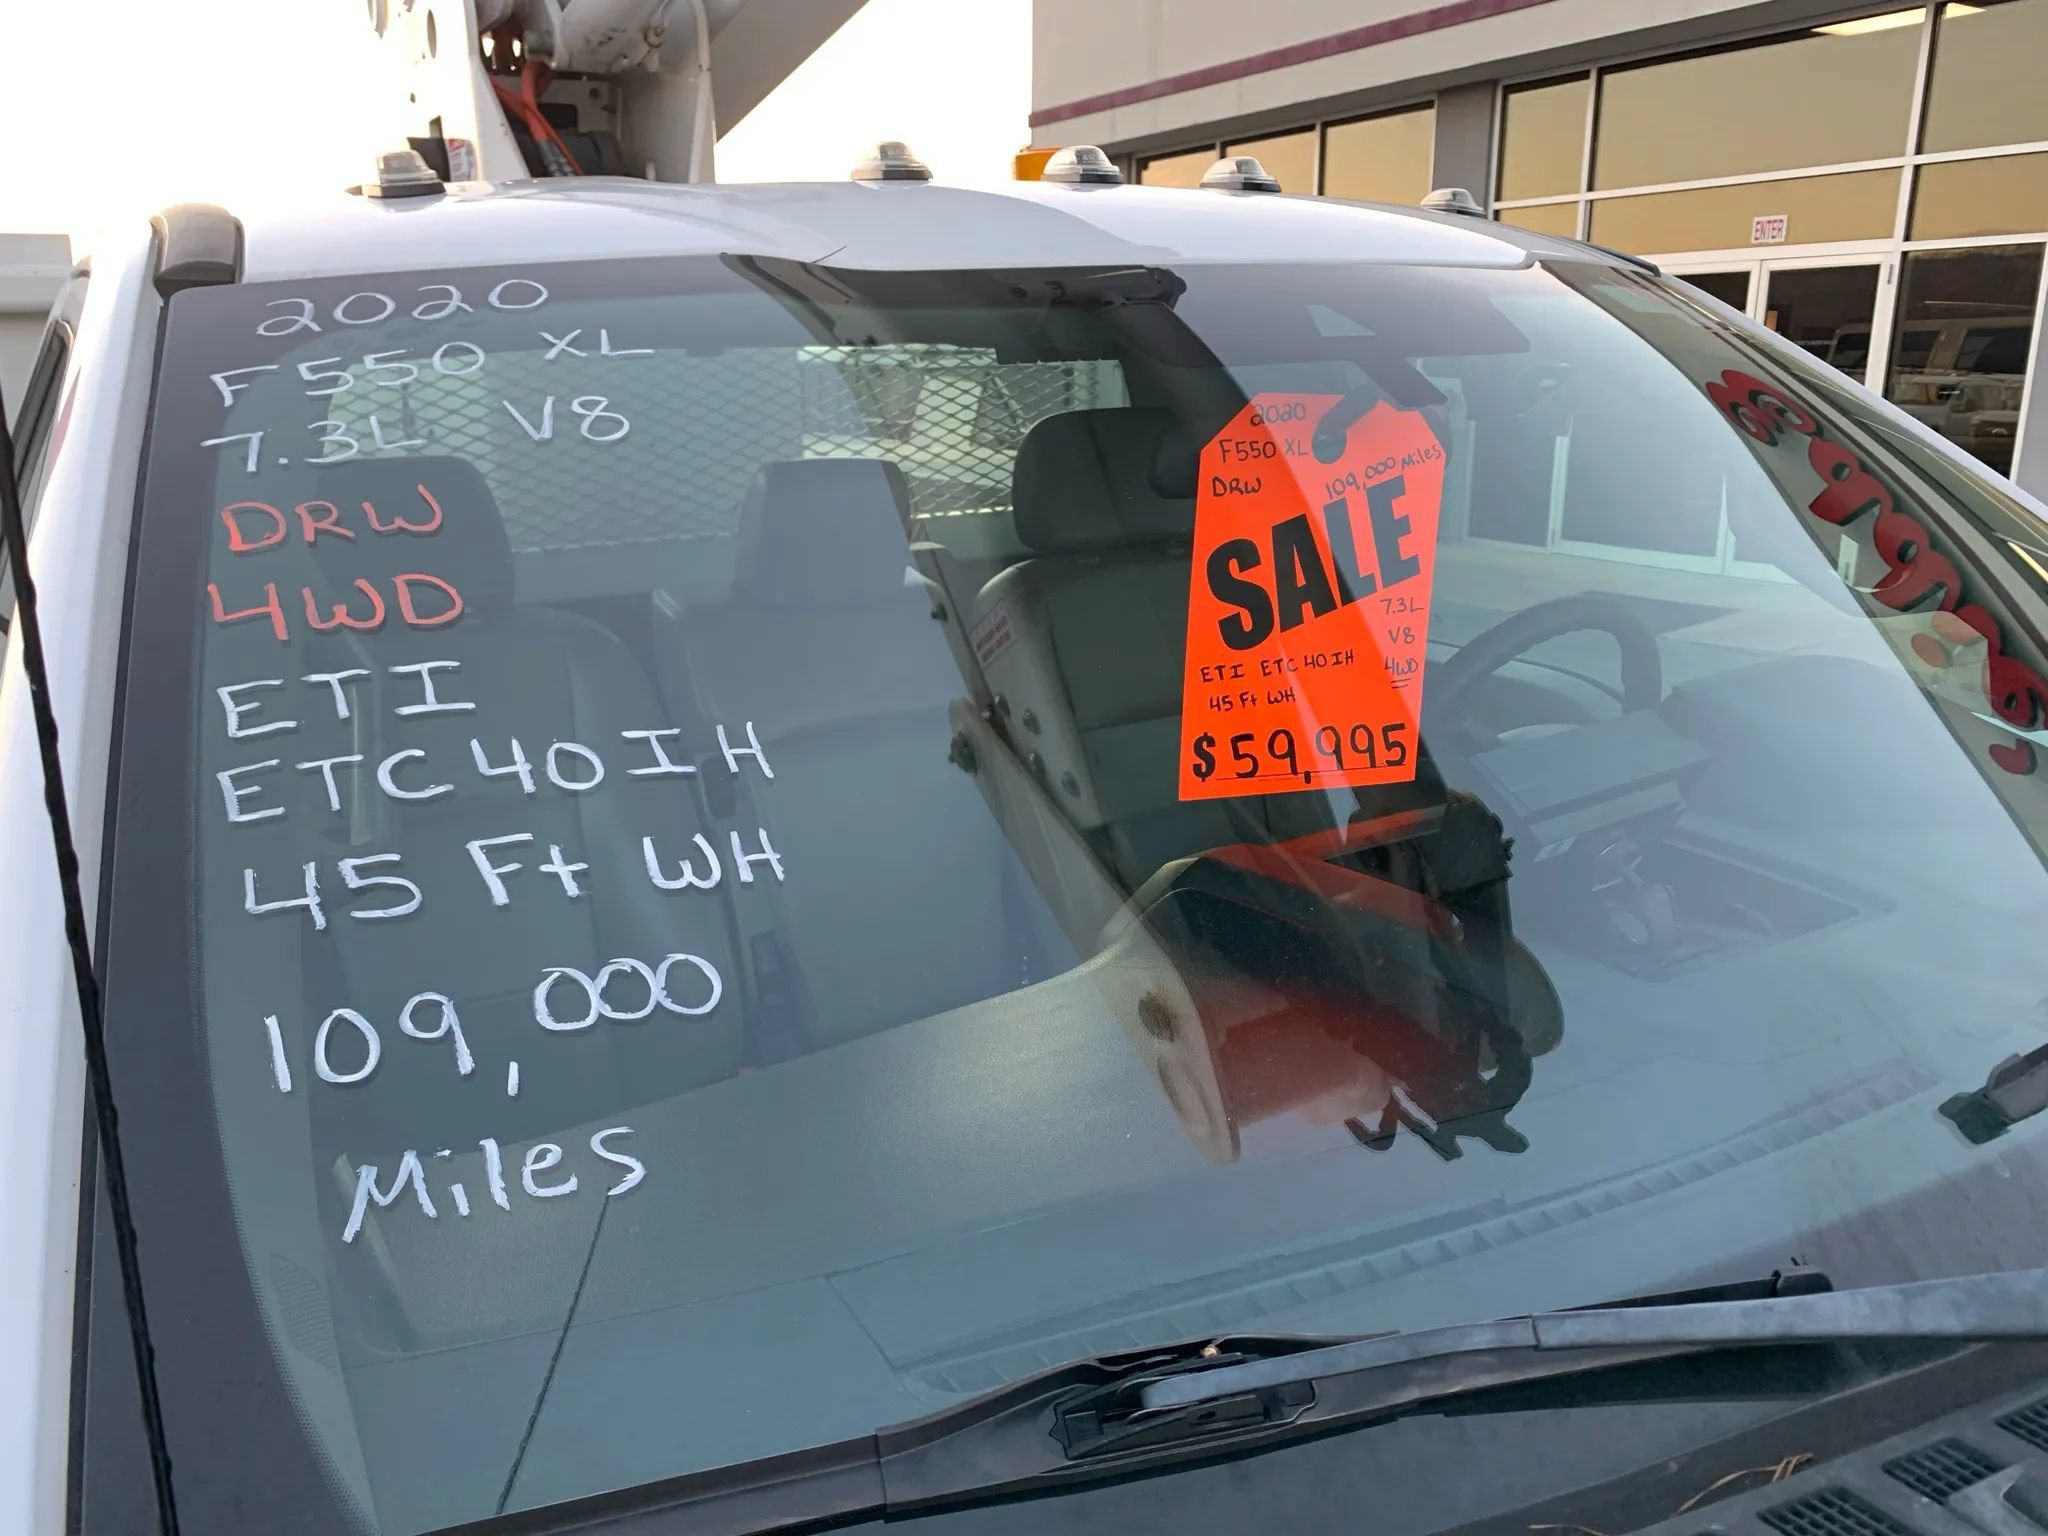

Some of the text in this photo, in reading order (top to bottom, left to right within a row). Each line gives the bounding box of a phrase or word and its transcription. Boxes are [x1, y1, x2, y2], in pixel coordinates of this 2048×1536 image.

[1754, 219, 1784, 241] ENTER
[255, 279, 549, 336] 2020
[209, 328, 656, 407] F550 XL
[200, 395, 632, 472] 7.3L V8
[1249, 402, 1307, 427] 2020
[1218, 438, 1309, 463] F550 XL
[1325, 443, 1442, 500] 109,000 Miles
[1211, 475, 1262, 497] DRW
[220, 484, 444, 551] DRW
[1205, 473, 1421, 651] SALE
[207, 572, 464, 641] 4WD
[1379, 597, 1424, 615] 7.3L
[1388, 626, 1416, 644] V8
[1200, 663, 1246, 683] ETI
[1384, 656, 1419, 676] 4WD
[216, 659, 477, 739] ETI
[1209, 694, 1234, 712] 45
[1266, 686, 1297, 705] WH
[1192, 722, 1408, 784] $59,995
[243, 853, 423, 931] 45
[642, 828, 786, 890] WH
[263, 953, 723, 1097] 109,000
[341, 1126, 648, 1244] Miles
